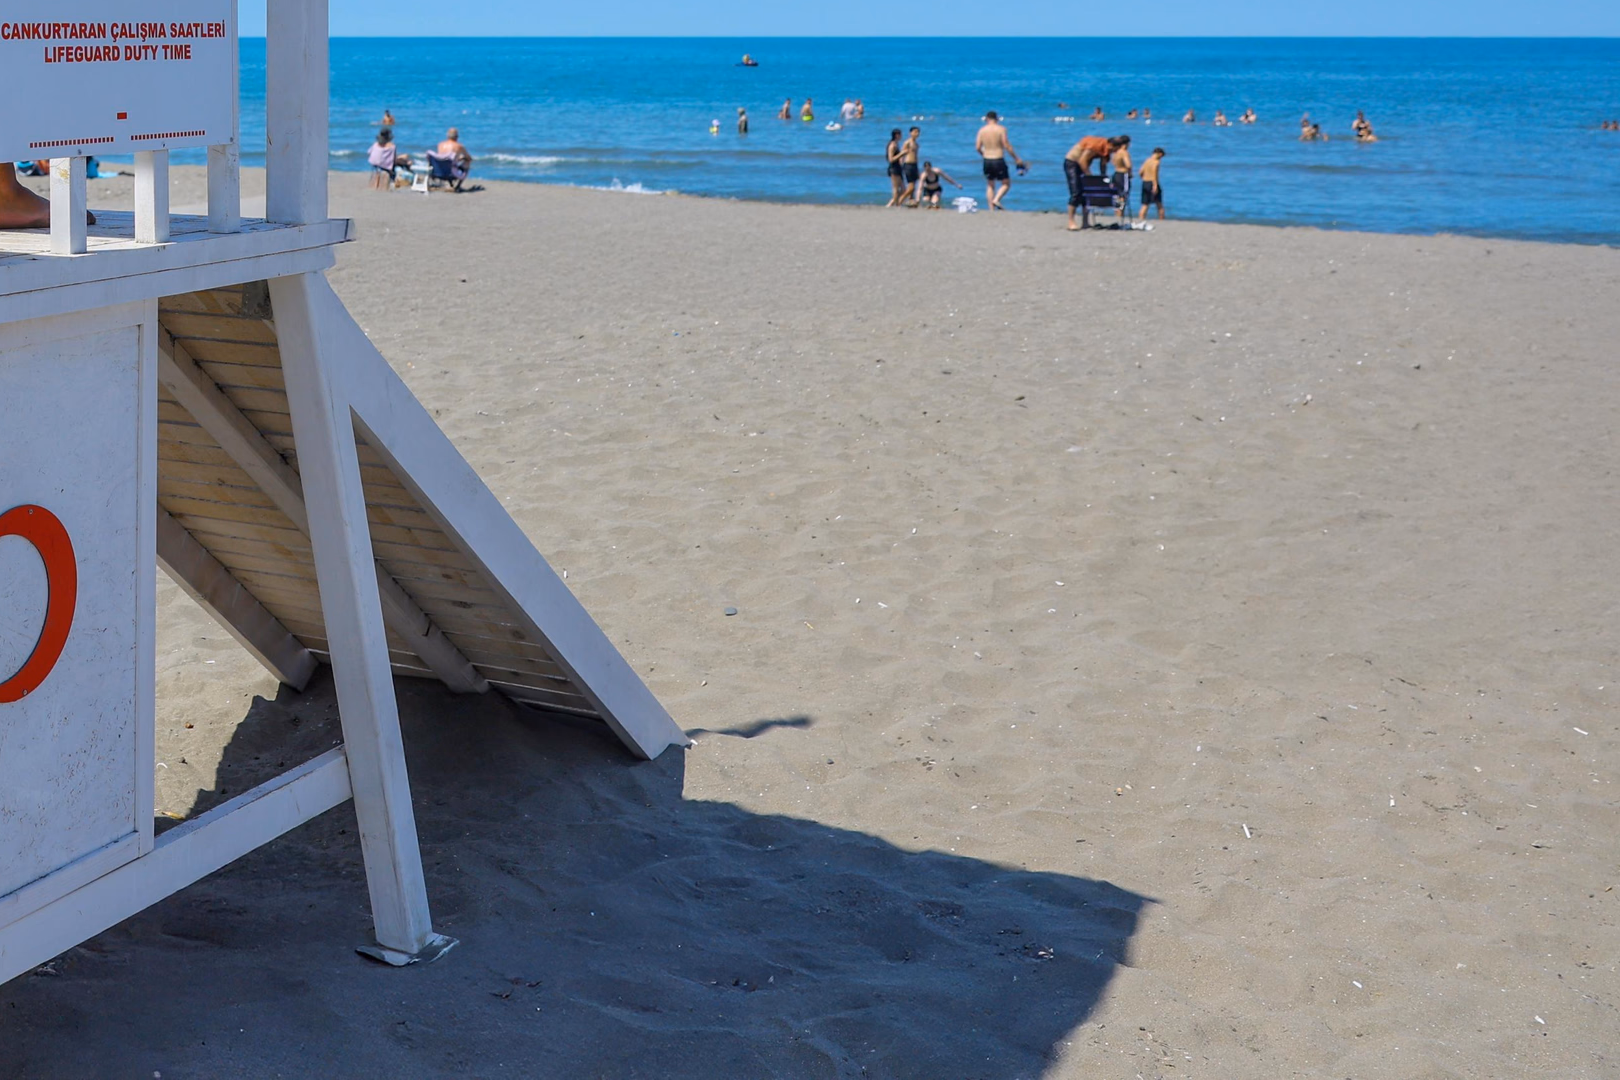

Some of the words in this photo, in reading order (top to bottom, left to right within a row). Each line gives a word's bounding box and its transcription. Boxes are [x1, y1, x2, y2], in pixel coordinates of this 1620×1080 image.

[1, 22, 107, 40] CANKURTARAN
[110, 22, 167, 43] ÇALIŞMA
[169, 19, 226, 38] SAATLERİ
[44, 46, 121, 63] LIFEGUARD
[124, 44, 158, 61] DUTY
[162, 44, 192, 60] TIME
